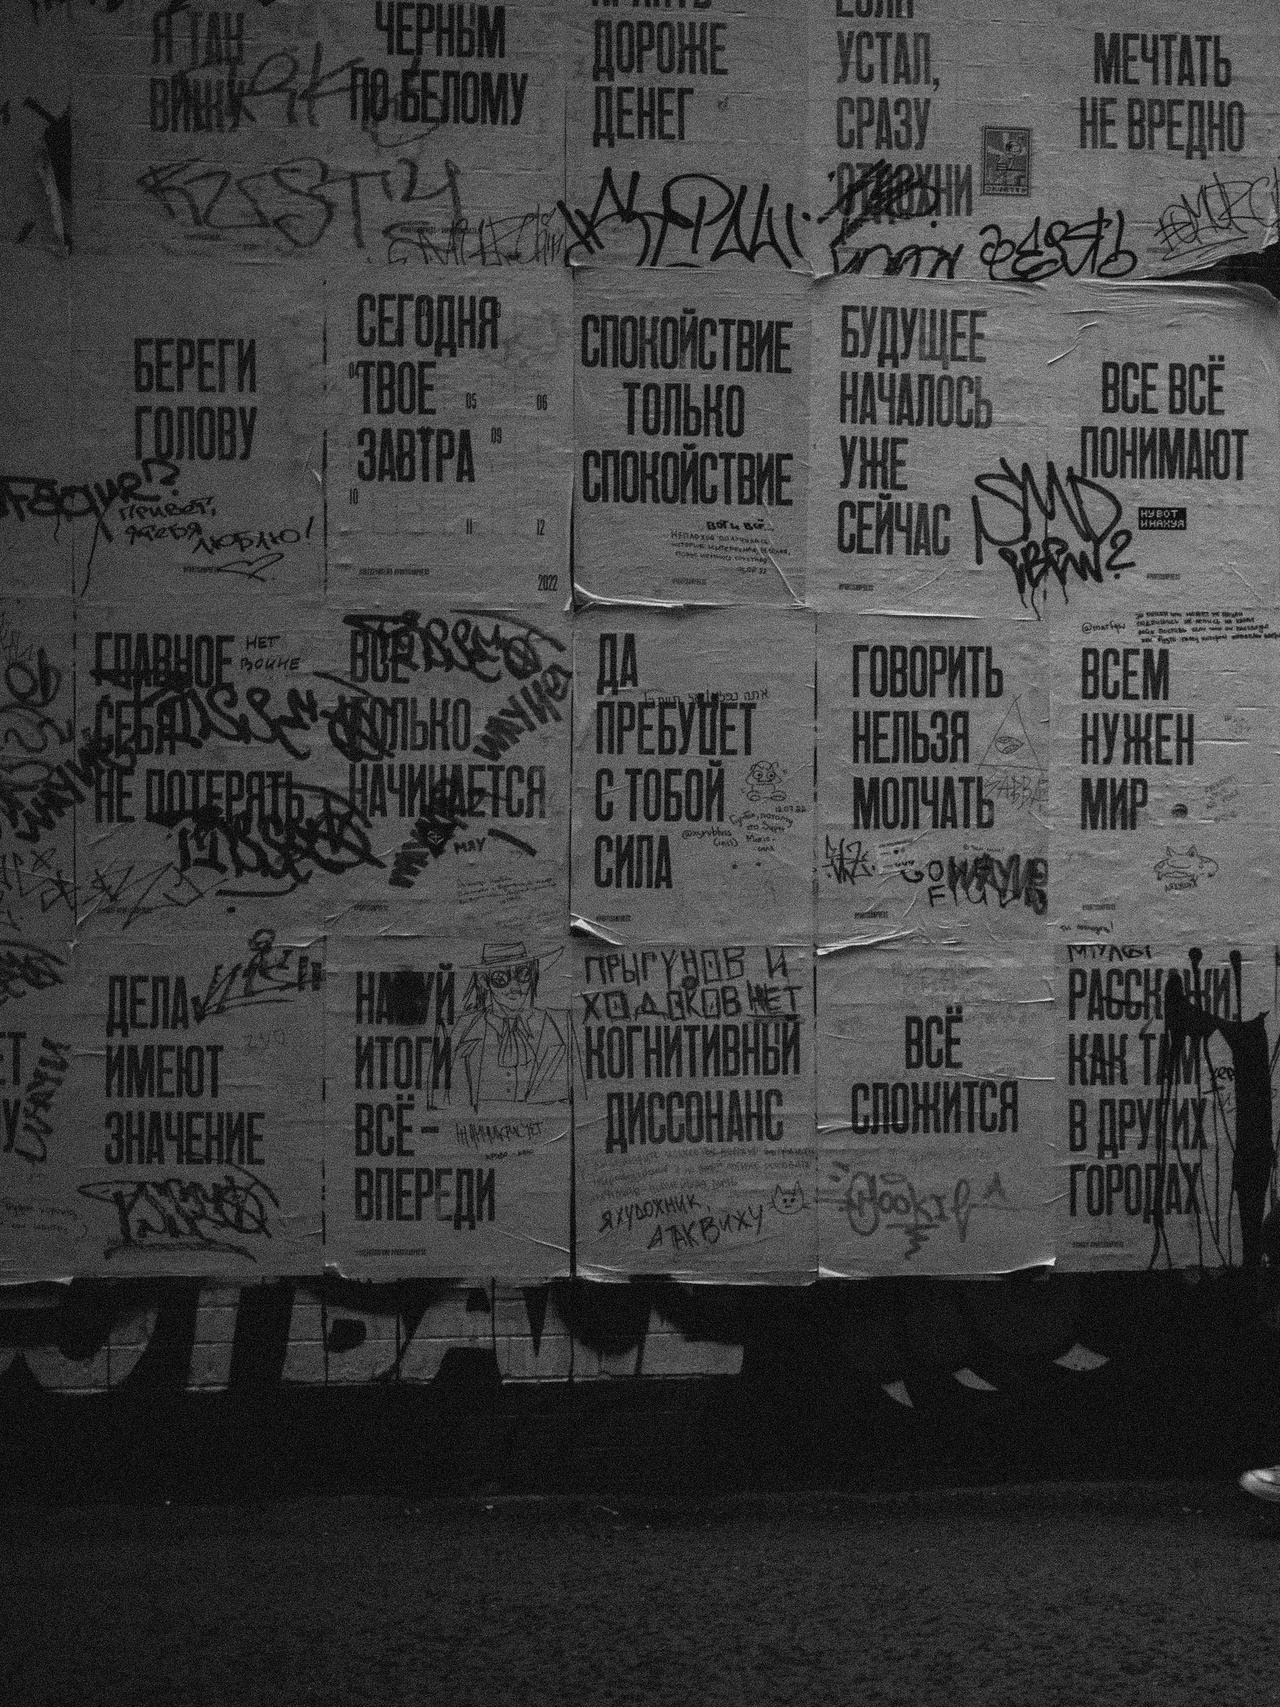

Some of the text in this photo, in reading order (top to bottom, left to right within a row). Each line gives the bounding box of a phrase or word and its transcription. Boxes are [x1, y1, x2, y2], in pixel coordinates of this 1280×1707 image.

[376, 2, 505, 58] ЧЕРНЫМ
[593, 20, 728, 81] ДОРОЖЕ
[837, 31, 939, 91] УСТАЛ,
[1094, 33, 1232, 88] МЕЧТАТЬ
[150, 77, 244, 132] ВИЖУ
[351, 67, 527, 126] ПО БЕЛОМУ
[593, 87, 694, 147] ДЕНЕГ
[836, 97, 931, 151] СРАЗУ
[1080, 97, 1245, 160] НЕ ВРЕДНО
[357, 293, 501, 357] СЕГОДНЯ
[581, 308, 793, 374] СПОКОЙСТВИЕ
[841, 305, 987, 370] БУДУЩЕЕ
[135, 338, 257, 393] БЕРЕГИ
[358, 360, 436, 416] ТВОЕ
[1101, 355, 1225, 416] ВСЕ ВСЁ
[622, 382, 745, 438] ТОЛЬКО
[840, 371, 993, 429] НАЧАЛОСЬ
[135, 406, 257, 460] ГОЛОВУ
[357, 428, 475, 484] ЗАВТРА
[1080, 427, 1250, 481] ПОНИМАЮТ
[582, 443, 793, 507] СПОКОЙСТВИЕ
[840, 436, 909, 491] УЖЕ
[837, 494, 951, 556] СЕЙЧАС
[96, 633, 234, 686] ГЛАВНОЕ
[246, 635, 280, 649] НЕТ
[597, 633, 638, 694] ДА
[852, 645, 1003, 698] ГОВОРИТЬ
[1082, 647, 1170, 700] ВСЕМ
[597, 697, 756, 756] ПРЕБУДЕТ
[853, 711, 969, 764] НЕЛЬЗЯ
[1081, 713, 1194, 766] НУЖЕН
[96, 769, 305, 823] НЕ ПОТЕРЯТЬ
[351, 764, 546, 819] НАЧИНАЕТСЯ
[596, 760, 725, 822] С ТОБОЙ
[853, 776, 994, 829] МОЛЧАТЬ
[1081, 777, 1148, 831] МИР
[594, 835, 673, 889] СИЛА
[108, 975, 190, 1037] ДЕЛА
[355, 1036, 452, 1090] ИТОГИ
[586, 1014, 800, 1079] КОГНИТИВНЫЙ
[905, 1006, 963, 1070] ВСЁ
[1068, 1033, 1128, 1086] КАК
[107, 1045, 224, 1097] ИМЕЮТ
[355, 1094, 415, 1157] ВСЁ
[606, 1090, 783, 1153] ДИССОНАНС
[851, 1081, 1019, 1135] СЛОЖИТСЯ
[1069, 1099, 1208, 1158] В ДРУГИХ
[104, 1112, 265, 1165] ЗНАЧЕНИЕ
[355, 1168, 496, 1230] ВПЕРЕДИ
[1069, 1164, 1201, 1222] ГОРОДАХ
